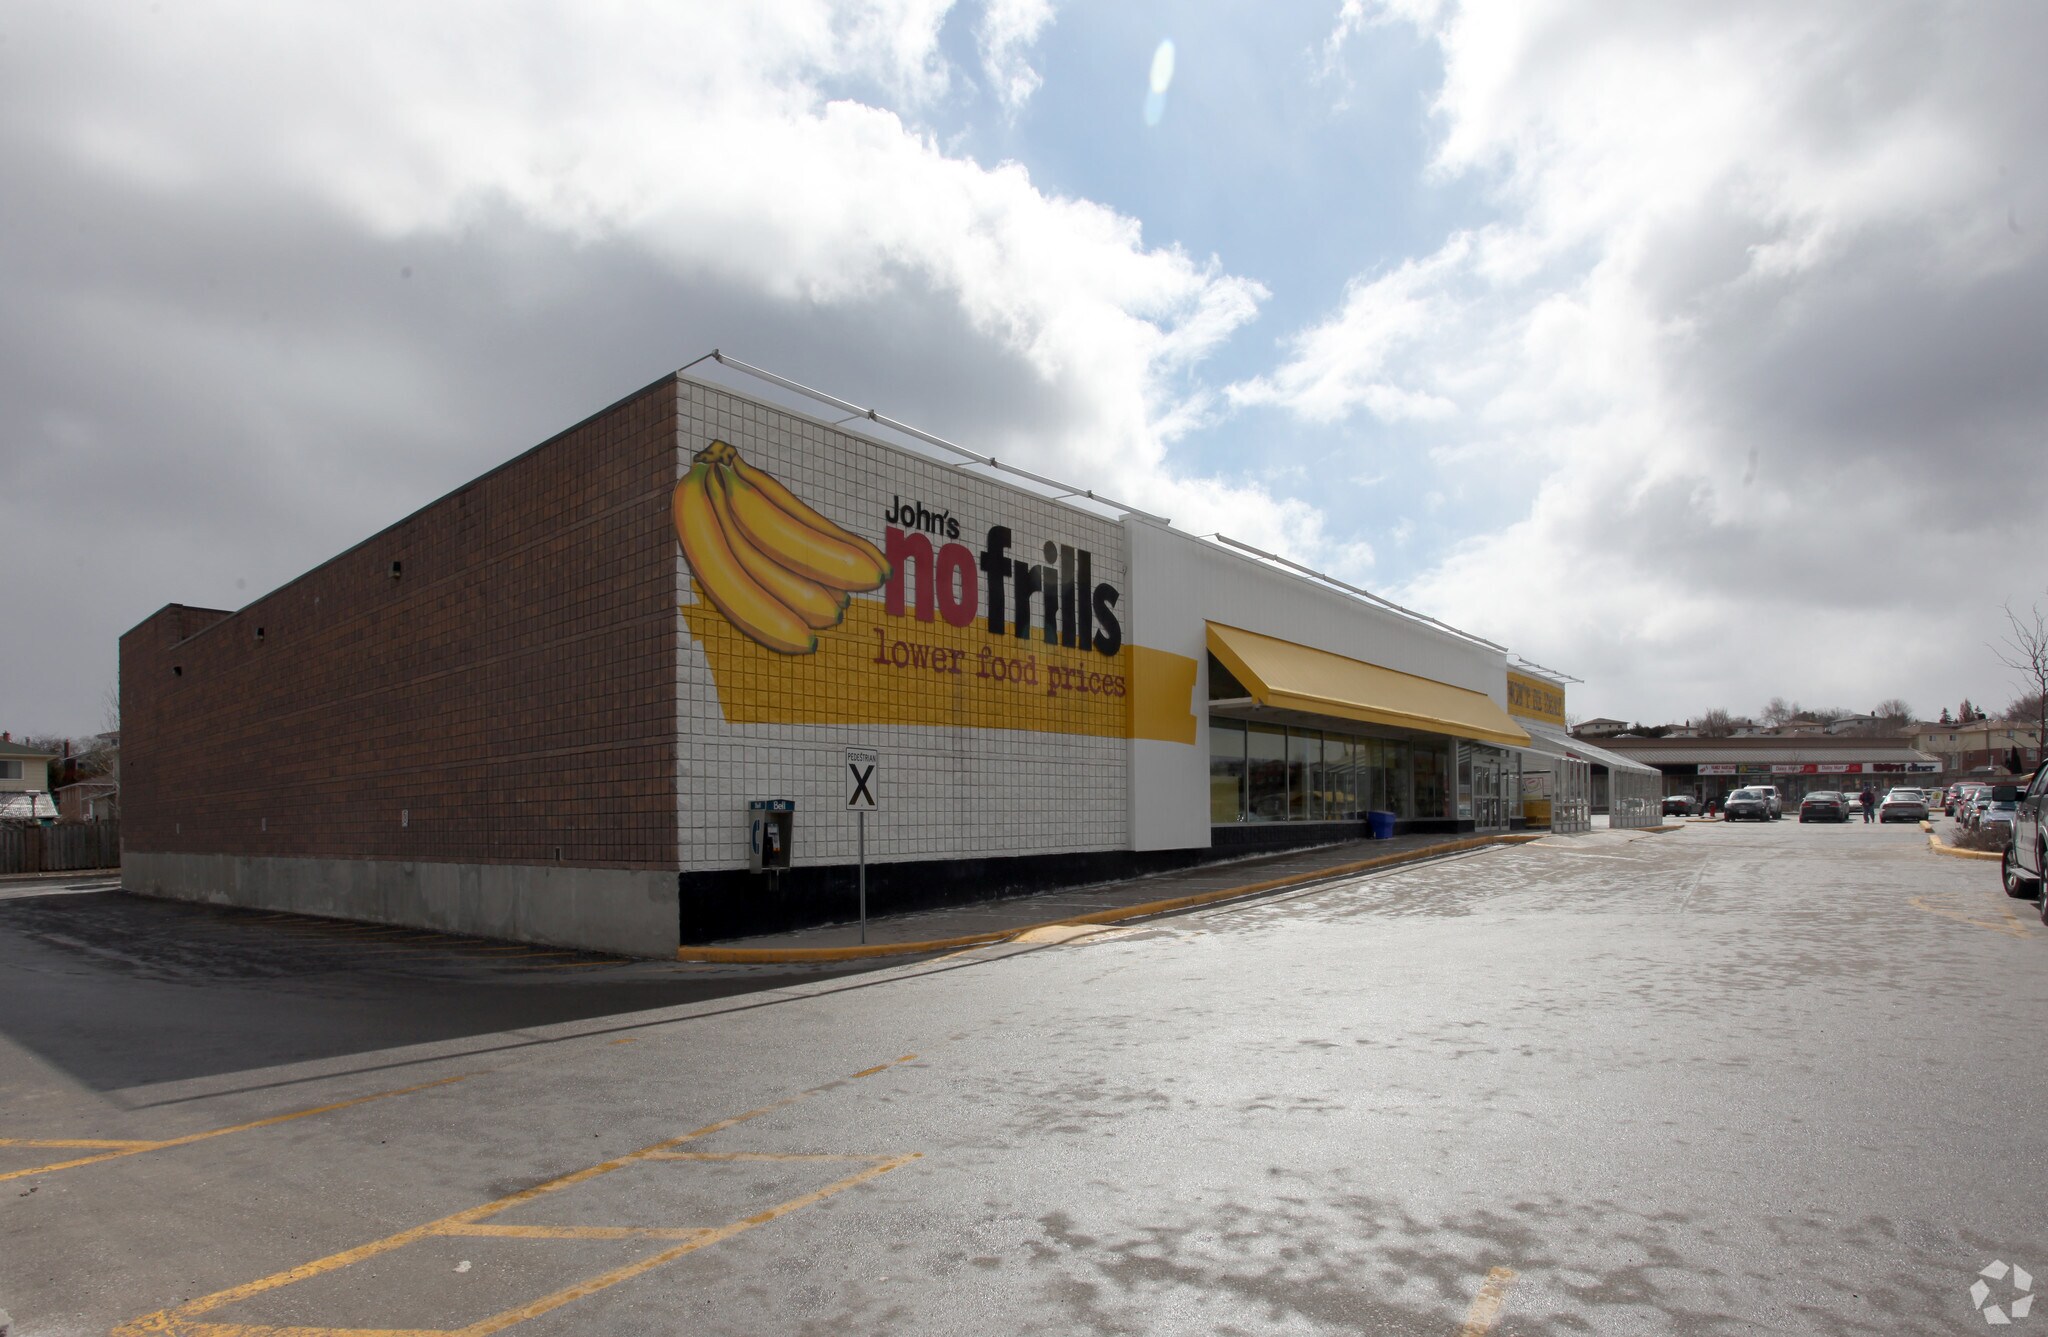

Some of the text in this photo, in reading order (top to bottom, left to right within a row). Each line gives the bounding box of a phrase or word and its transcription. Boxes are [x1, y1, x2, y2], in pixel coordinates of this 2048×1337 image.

[885, 495, 960, 539] John's
[885, 525, 1122, 656] no frills
[873, 627, 1127, 697] lower food prices
[847, 752, 876, 762] PEDESTRIAN
[773, 800, 786, 810] Bell
[848, 763, 875, 806] X
